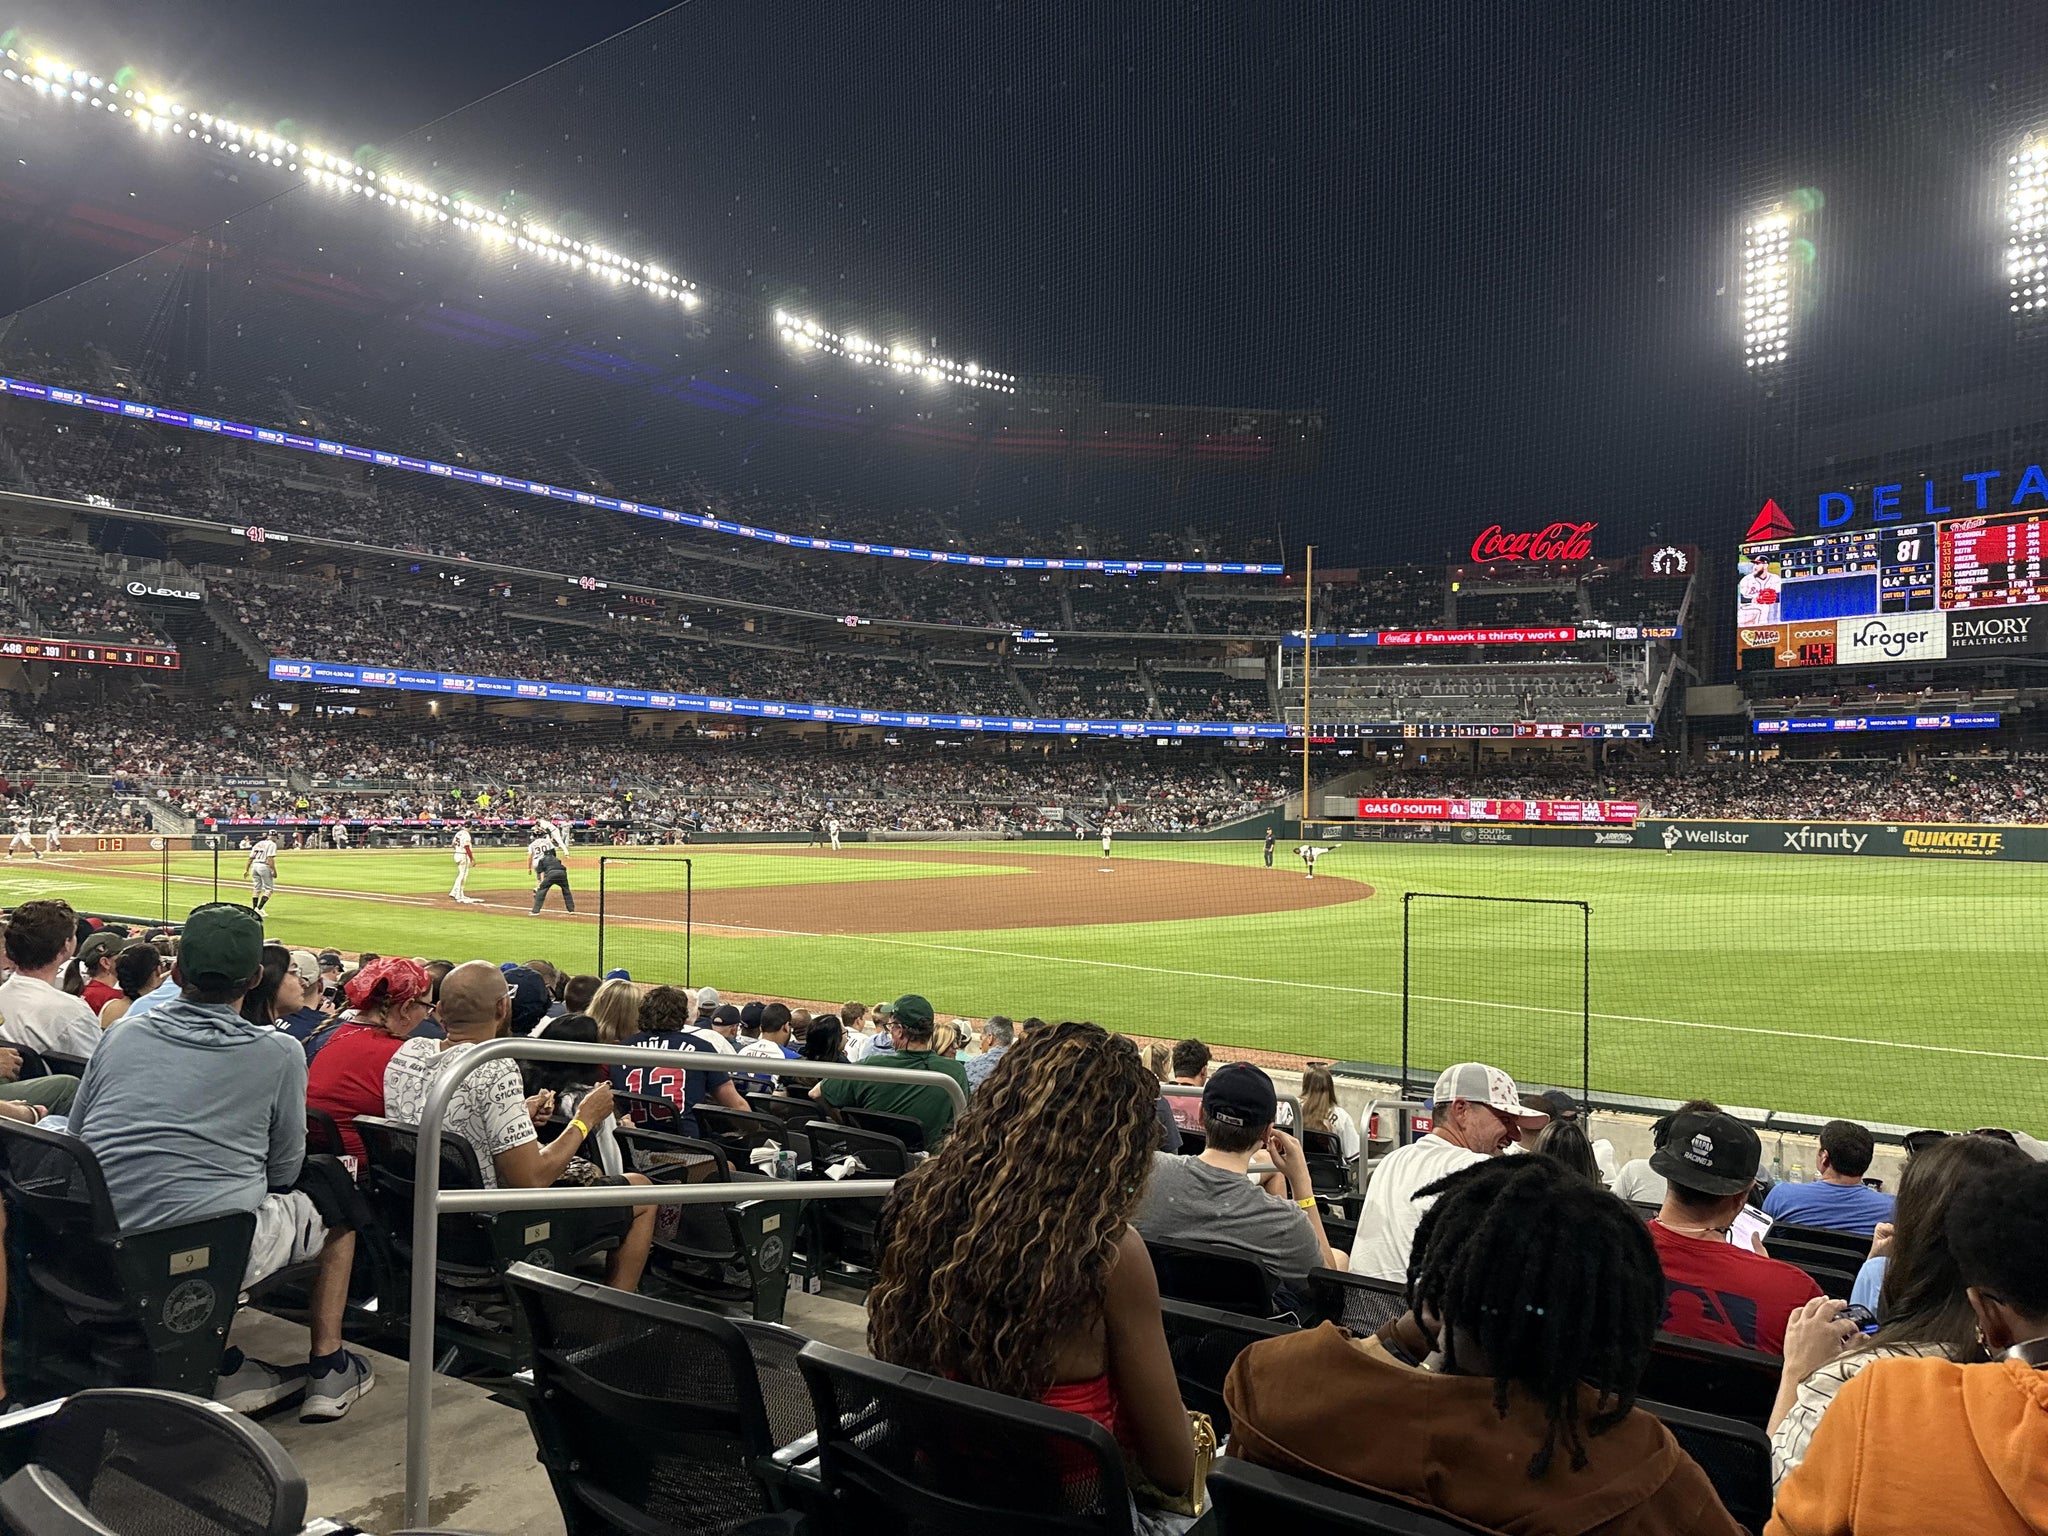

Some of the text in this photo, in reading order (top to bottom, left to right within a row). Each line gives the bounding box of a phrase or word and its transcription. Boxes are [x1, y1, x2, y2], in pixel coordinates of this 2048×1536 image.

[73, 394, 83, 405] 2
[145, 408, 154, 419] 2
[212, 421, 221, 431] 2
[1819, 464, 2048, 527] DELTA
[246, 525, 265, 543] 41
[1897, 527, 1918, 537] SLIDER
[2007, 525, 2016, 534] SS
[1471, 521, 1598, 562] Coca-Cola
[1942, 541, 1951, 550] 25
[1955, 538, 1977, 547] TORRES
[1897, 539, 1920, 562] 81
[2007, 549, 2016, 557] LF
[1817, 566, 1824, 576] 0
[1850, 563, 1857, 572] 0
[1785, 569, 1791, 578] 0
[1942, 571, 1952, 579] 30
[1954, 568, 1989, 578] CARPENTER
[579, 576, 595, 590] 44
[1942, 576, 1989, 587] 20 TORKELSON
[148, 586, 201, 600] LEXUS
[1912, 589, 1931, 598] LAUNCH
[1941, 589, 1954, 599] 46
[2014, 579, 2028, 588] FOR
[1982, 590, 1993, 598] SLG
[2008, 587, 2021, 596] OPS
[629, 595, 656, 605] SLICE
[1944, 601, 1951, 609] 17
[845, 615, 859, 627] 47
[1641, 628, 1677, 638] $16,257
[1952, 617, 2032, 638] EMORY
[1426, 633, 1445, 642] Fan
[1447, 632, 1474, 642] work
[1477, 632, 1487, 641] is
[1488, 631, 1524, 642] thirsty
[1527, 630, 1556, 641] work
[1577, 629, 1595, 640] 8:41
[1597, 629, 1611, 639] PM
[1854, 621, 1929, 657] Kroger
[1952, 635, 2028, 647] HEALTHCARE
[0, 643, 171, 666] .486 OBP .191 H 6 RBI 3 HR 2
[1805, 644, 1835, 660] 143
[1801, 657, 1835, 666] MILLION
[300, 666, 312, 678] 2
[386, 672, 396, 684] 2
[465, 679, 474, 690] 2
[538, 684, 547, 696] 2
[1433, 679, 1497, 694] AARON
[1508, 677, 1603, 696] TERRACE
[1780, 720, 1790, 731] 2
[1857, 718, 1867, 729] 2
[1940, 716, 1951, 728] 2
[1365, 804, 1442, 815] GAS SOUTH
[1450, 804, 1466, 815] AL
[1470, 801, 1487, 809] HOU
[1526, 802, 1536, 810] TB
[1582, 802, 1599, 810] LAA
[1470, 808, 1486, 816] BAL
[1582, 809, 1601, 817] CWS
[1479, 827, 1506, 835] SOUTH
[1479, 834, 1513, 842] COLLEGE
[1685, 829, 1750, 845] Wellstar
[1784, 825, 1869, 853] xfinity
[1902, 830, 2002, 848] QUIKRETE
[111, 838, 123, 851] 13
[254, 850, 265, 860] 77
[498, 1079, 517, 1092] IS MY
[625, 1067, 686, 1124] 13
[507, 1122, 527, 1135] IS MY
[1415, 1119, 1430, 1131] BE
[1694, 1138, 1711, 1152] NAPA
[1684, 1151, 1708, 1165] RACING
[534, 1228, 541, 1238] 8
[185, 1254, 194, 1267] 9
